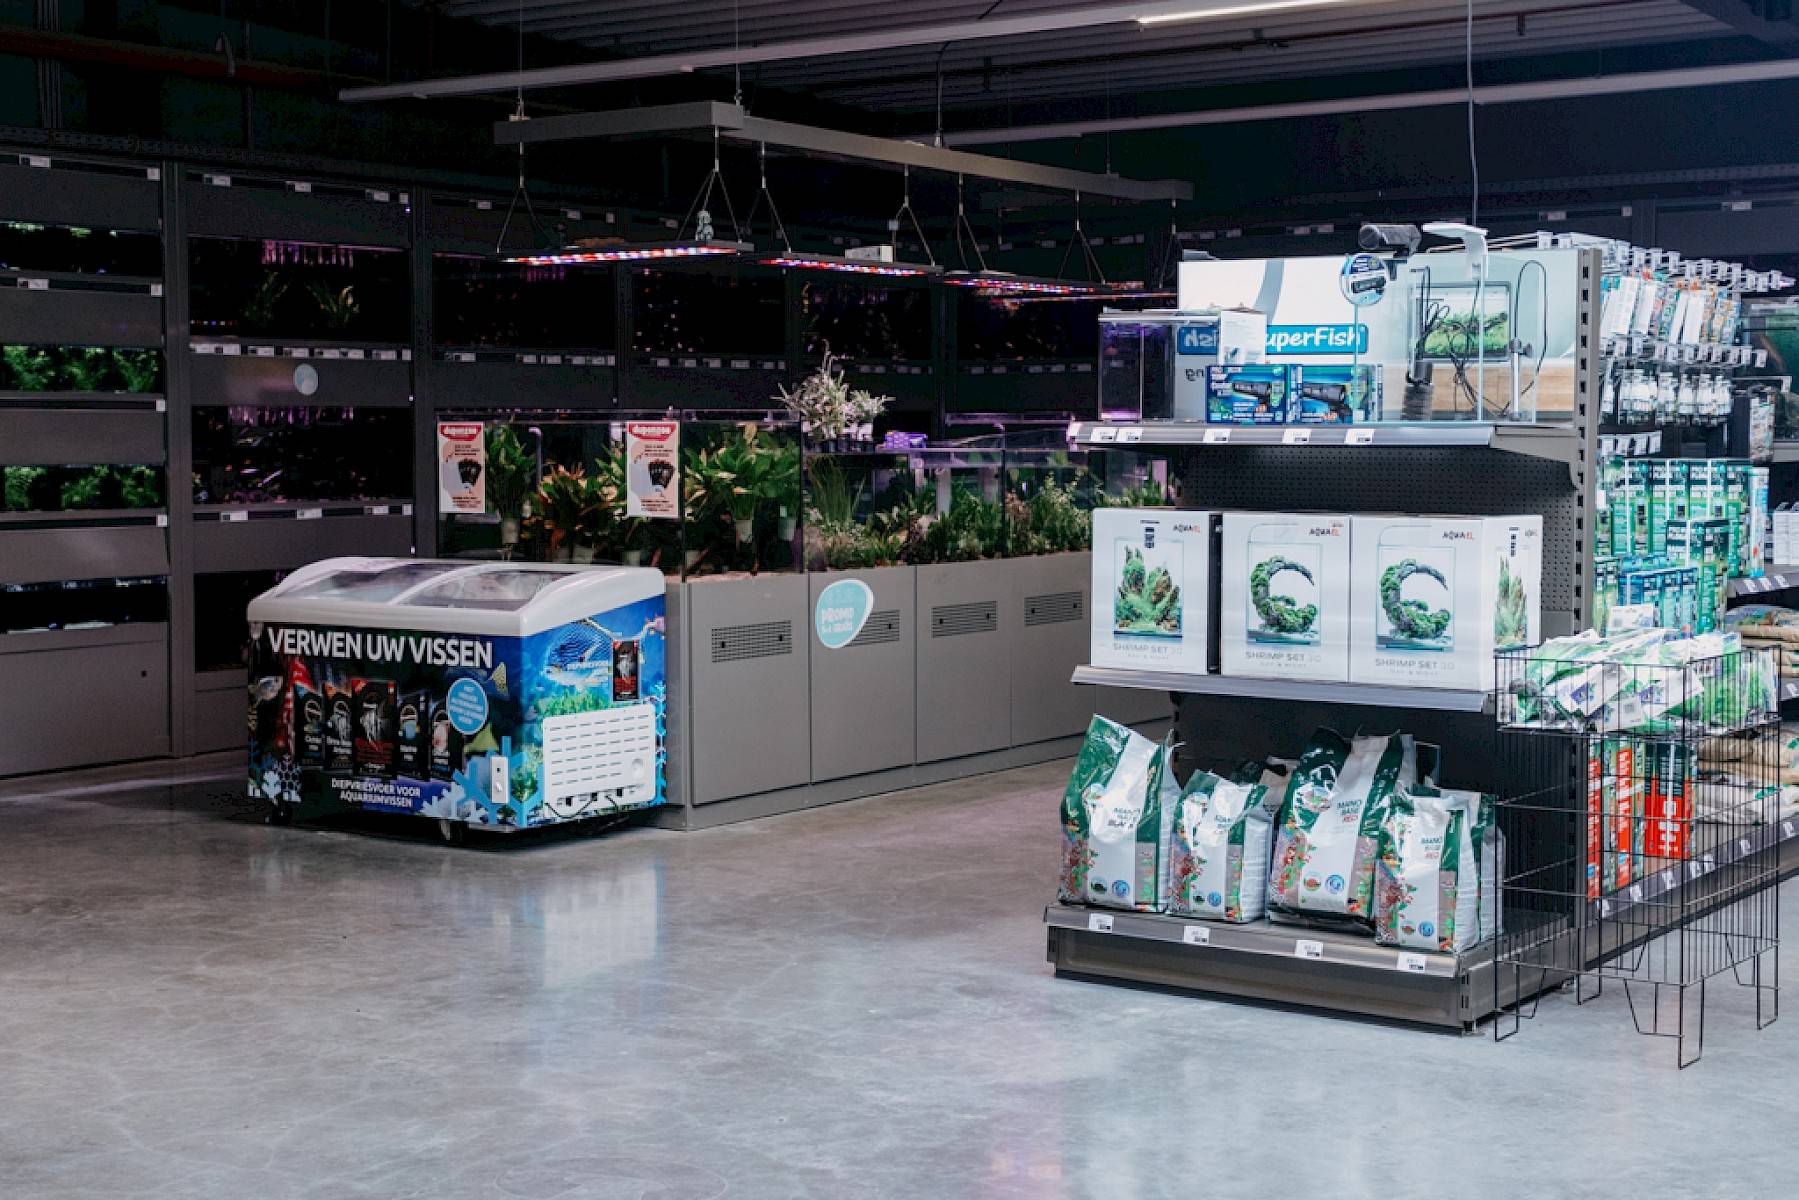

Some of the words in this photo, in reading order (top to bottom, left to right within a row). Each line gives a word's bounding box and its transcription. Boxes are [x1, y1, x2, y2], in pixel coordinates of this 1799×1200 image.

[1266, 326, 1360, 352] uperFish
[267, 627, 362, 659] VERWEN
[365, 634, 405, 663] UW
[408, 638, 493, 669] VISSEN
[1113, 642, 1149, 651] SHRIMP
[1151, 646, 1169, 654] SET
[1245, 651, 1283, 661] SHRIMP
[1286, 653, 1305, 662] SET
[1375, 658, 1417, 668] SHRIMP
[1418, 660, 1438, 669] SET
[397, 786, 421, 797] VOOR
